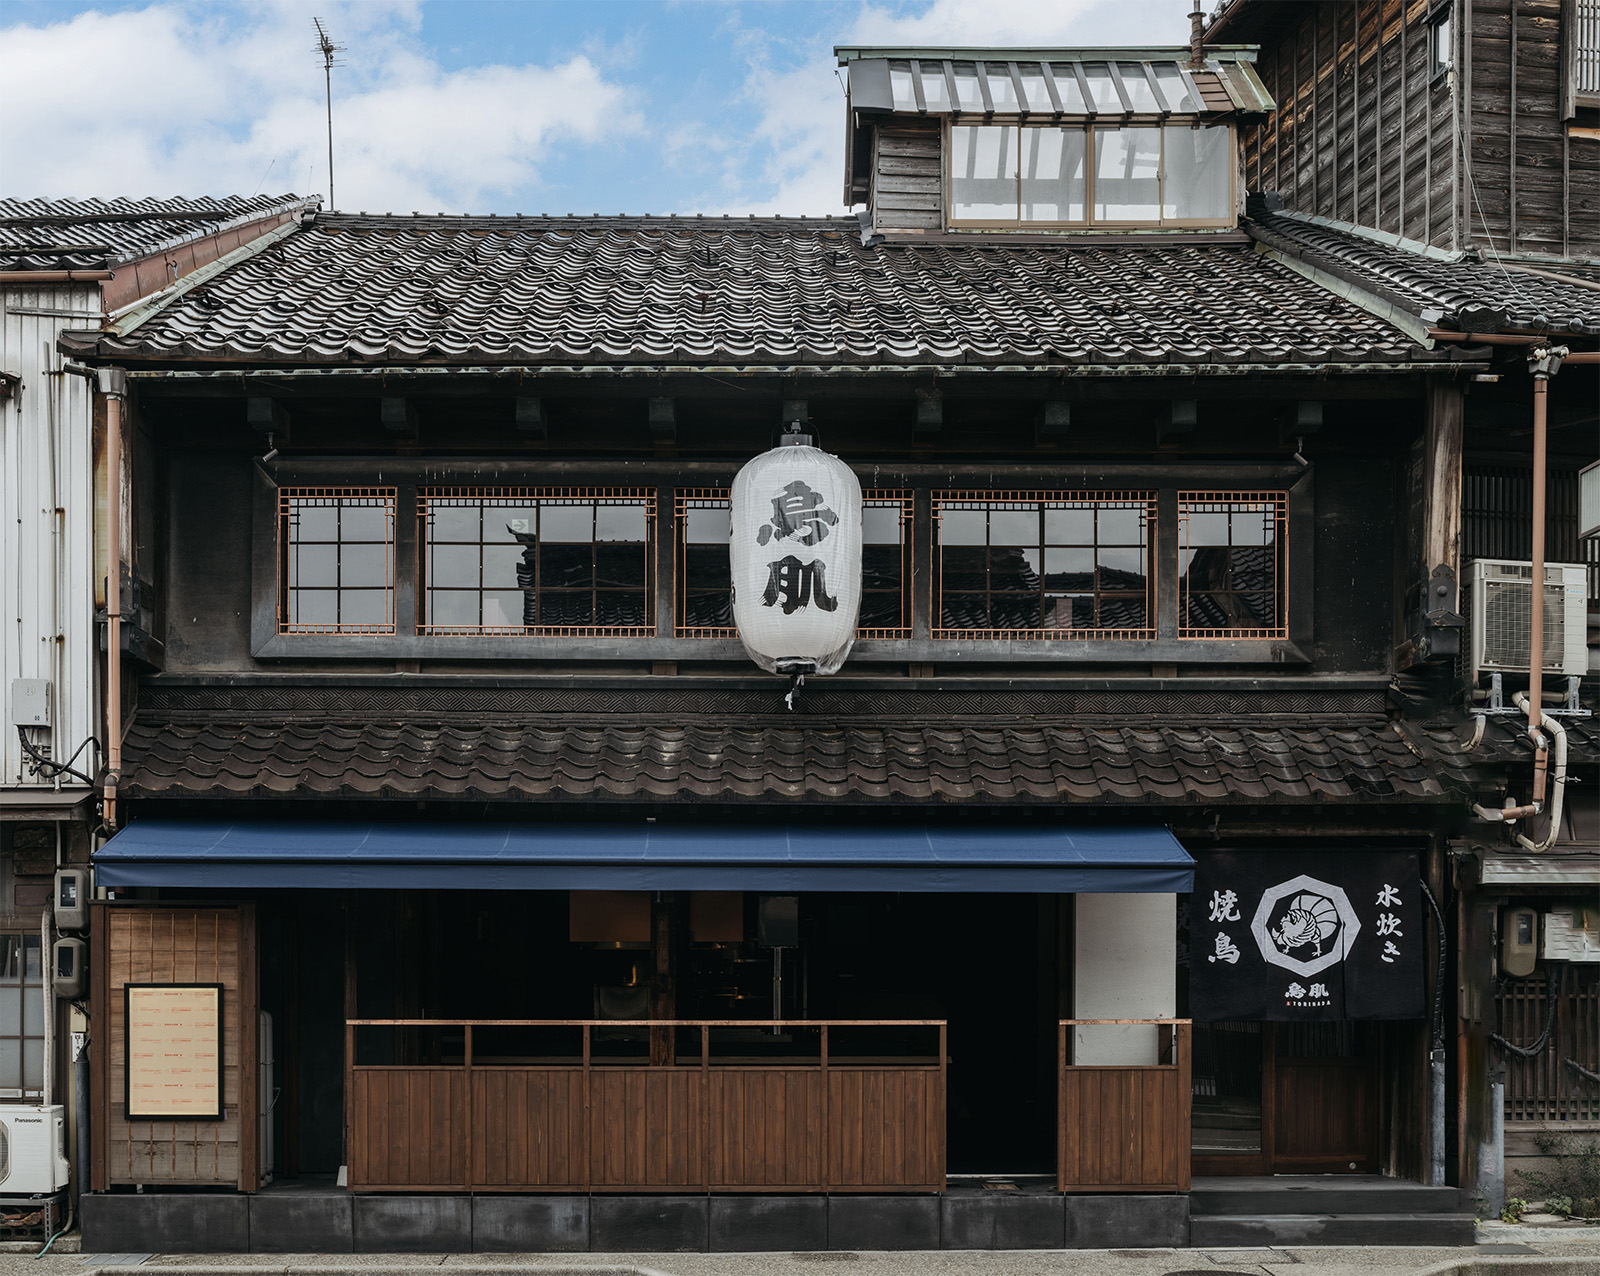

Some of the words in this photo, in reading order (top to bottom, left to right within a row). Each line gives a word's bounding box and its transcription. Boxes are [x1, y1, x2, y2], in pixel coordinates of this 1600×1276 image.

[756, 480, 840, 615] 鳥肌
[1208, 889, 1242, 965] 焼鳥
[1375, 884, 1404, 963] 水炊き
[1284, 982, 1330, 999] 鳥肌
